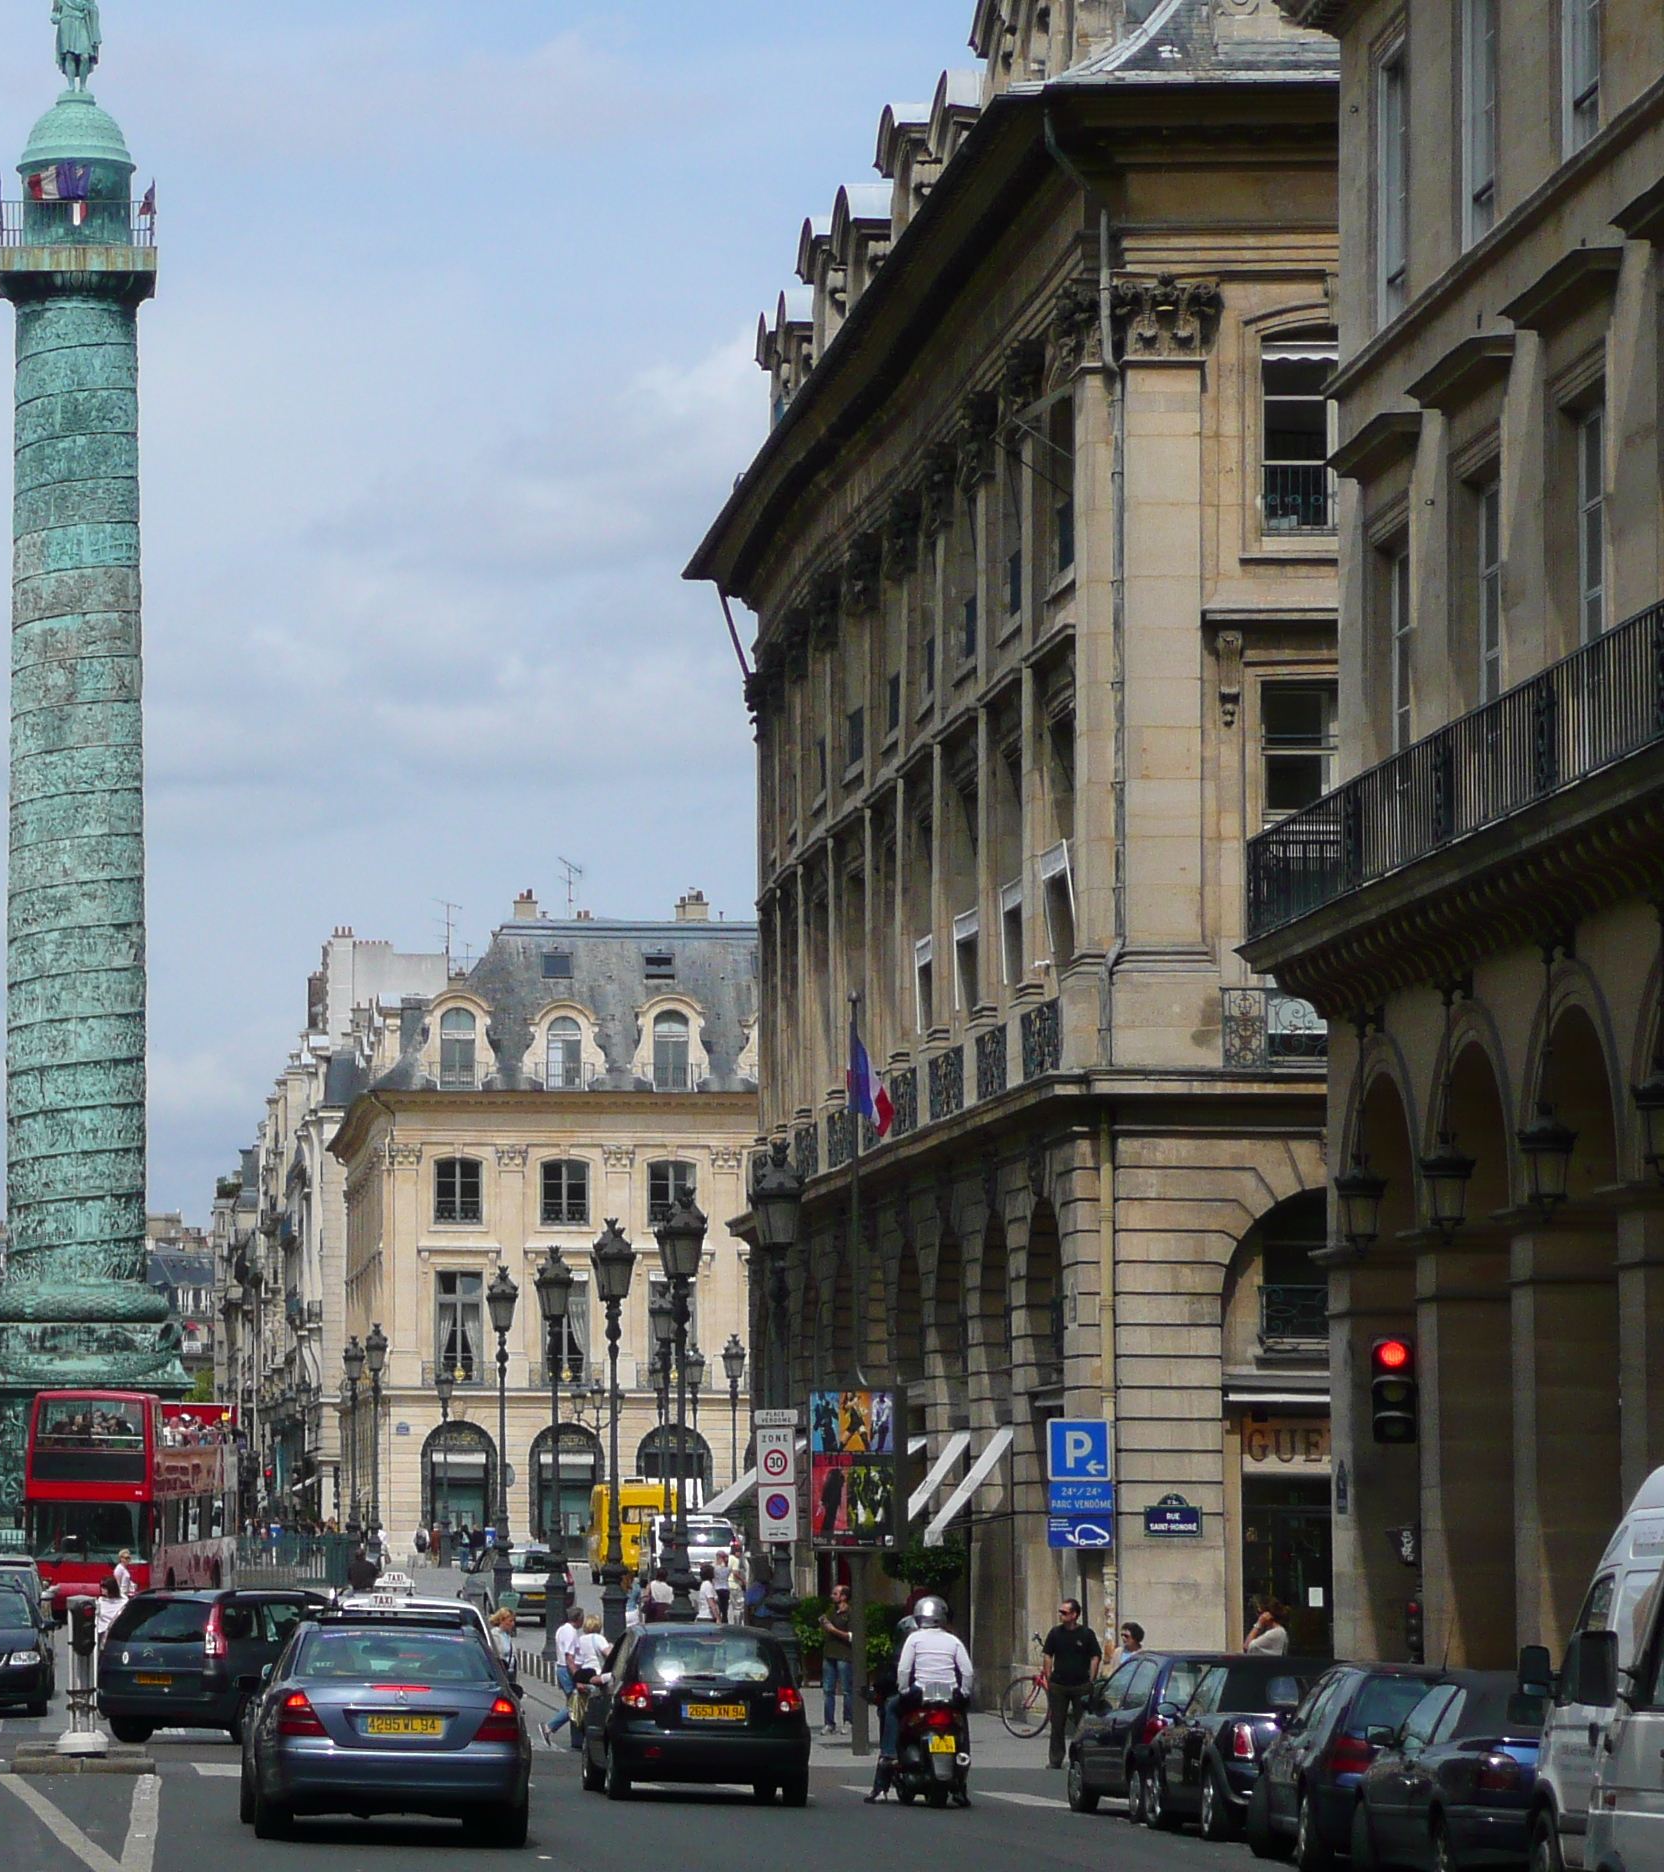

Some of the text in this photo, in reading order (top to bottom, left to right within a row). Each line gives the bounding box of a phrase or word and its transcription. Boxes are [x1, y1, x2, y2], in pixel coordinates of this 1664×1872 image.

[762, 1434, 788, 1443] ZONE
[1066, 1431, 1093, 1468] P
[1247, 1429, 1331, 1462] GUE
[769, 1457, 783, 1468] 30
[1051, 1499, 1112, 1508] PARC VENDÔME
[1166, 1512, 1181, 1520] RUE
[388, 1573, 403, 1581] TAXI
[373, 1595, 393, 1605] TAXI
[716, 1707, 729, 1716] XN
[732, 1708, 744, 1716] 94
[369, 1719, 400, 1730] 4295
[420, 1718, 436, 1731] 94
